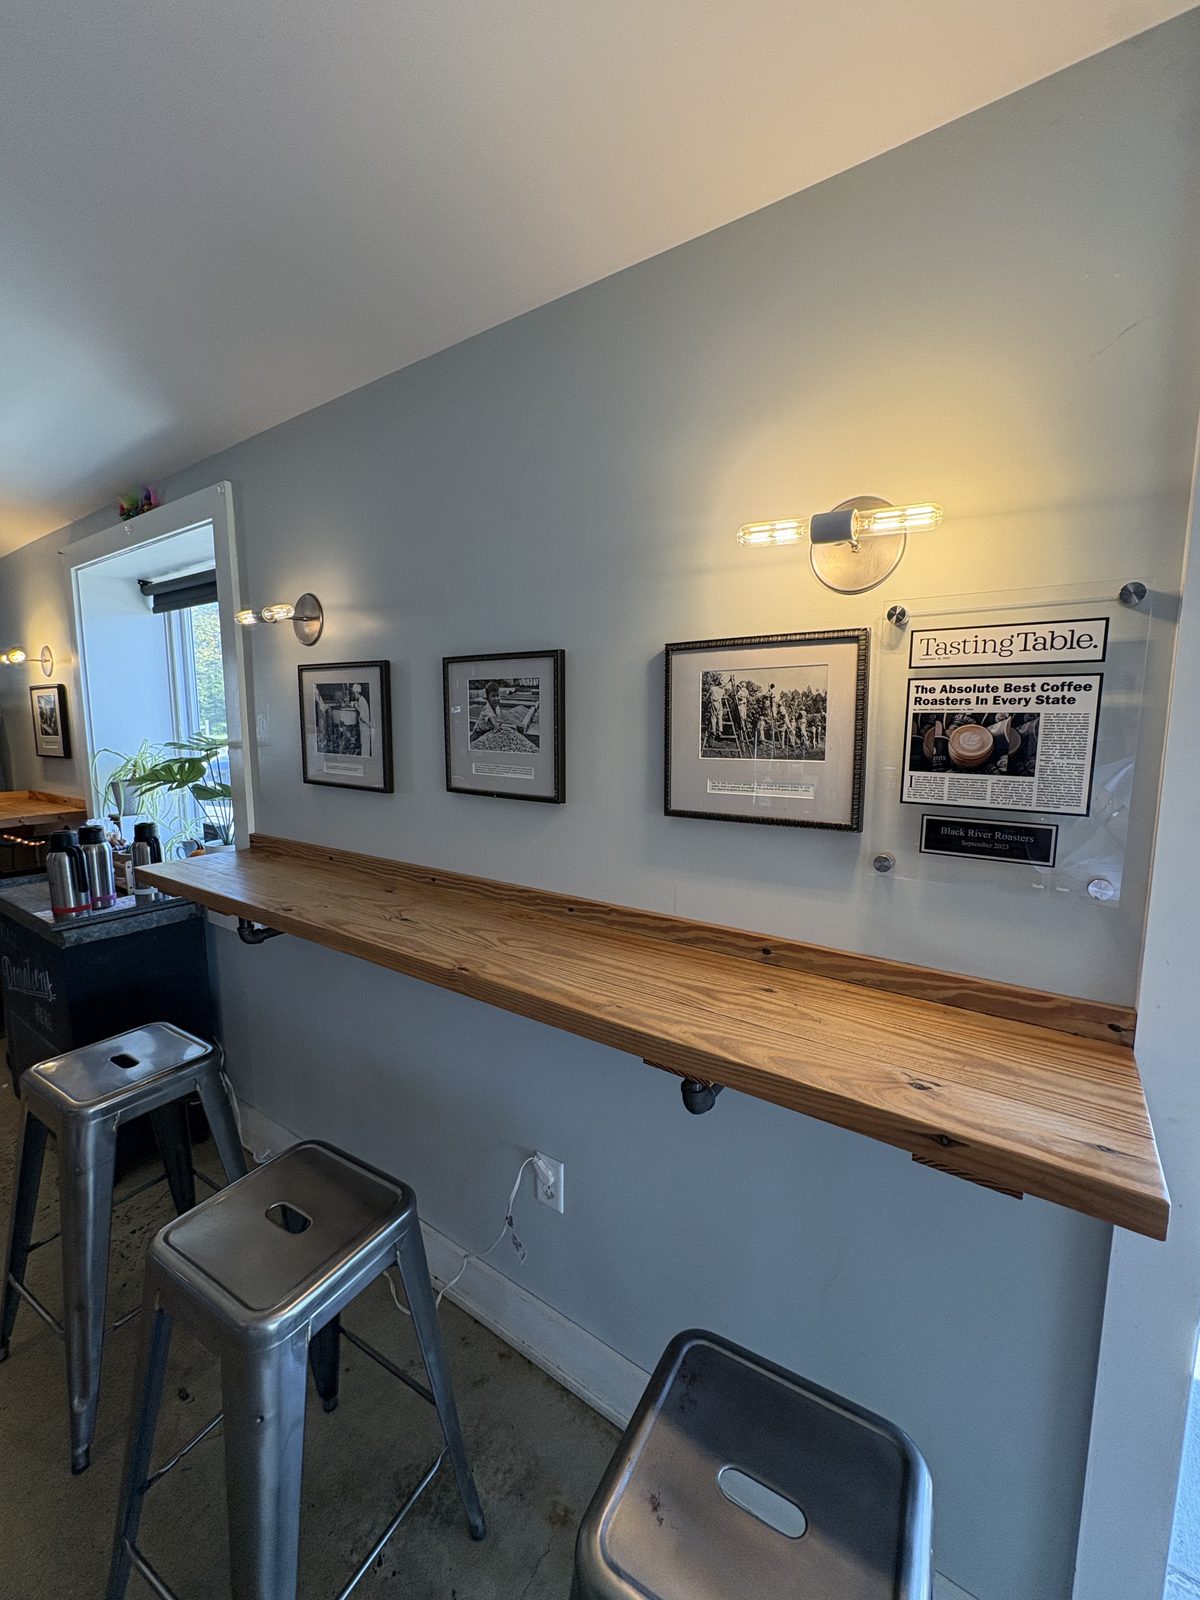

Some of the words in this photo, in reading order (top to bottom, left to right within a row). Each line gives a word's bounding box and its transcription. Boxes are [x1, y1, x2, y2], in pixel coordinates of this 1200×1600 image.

[919, 634, 1014, 658] Tasting
[1016, 629, 1098, 652] Table.
[914, 684, 936, 694] The
[939, 683, 999, 694] Absolute
[1003, 682, 1036, 693] Best
[1039, 681, 1093, 692] Coffee
[914, 696, 972, 706] Roasters
[975, 695, 987, 706] In
[992, 694, 1032, 707] Every
[1035, 694, 1077, 705] State
[940, 826, 965, 836] Black
[967, 829, 992, 839] River
[995, 831, 1035, 843] Roasters
[961, 839, 993, 849] September
